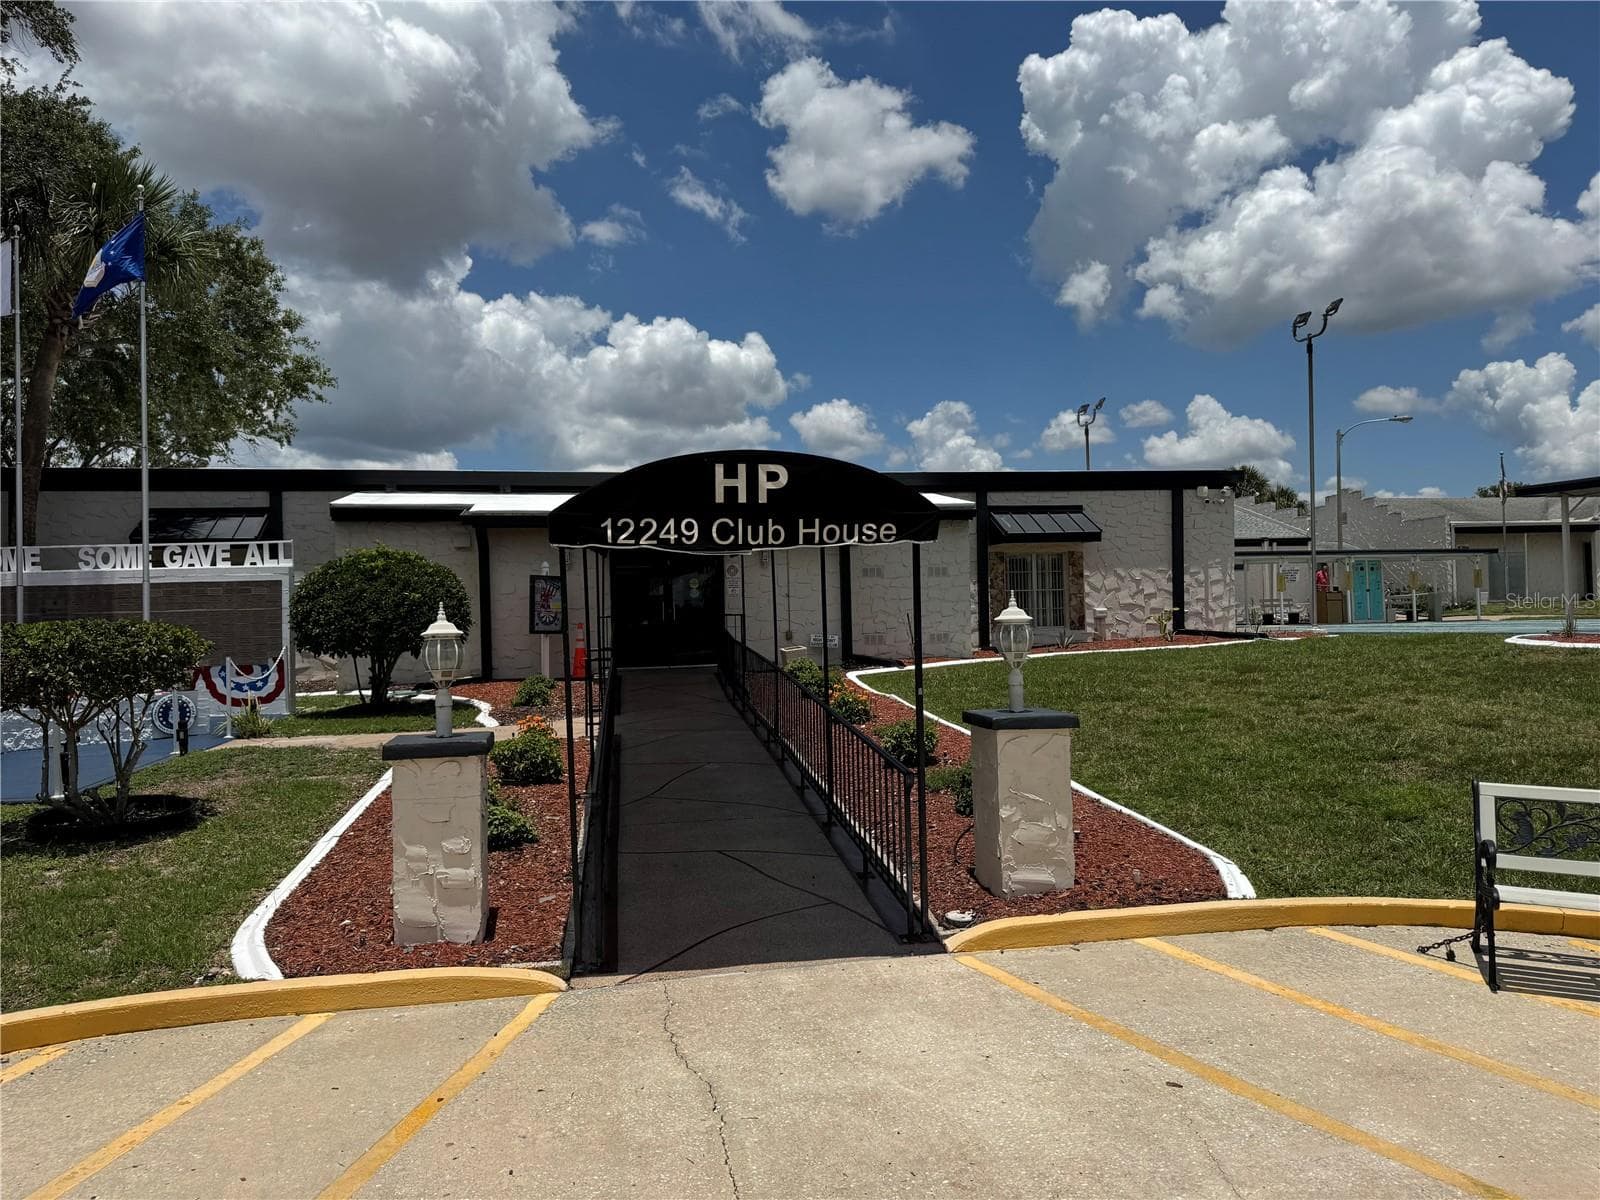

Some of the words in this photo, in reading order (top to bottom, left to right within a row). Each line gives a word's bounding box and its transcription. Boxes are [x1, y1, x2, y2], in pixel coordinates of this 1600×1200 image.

[714, 463, 788, 503] HP
[600, 518, 699, 545] 12249
[711, 518, 785, 545] Club
[799, 518, 897, 544] House
[0, 547, 42, 572] ME
[163, 544, 231, 569] GAVE
[244, 542, 293, 567] ALL
